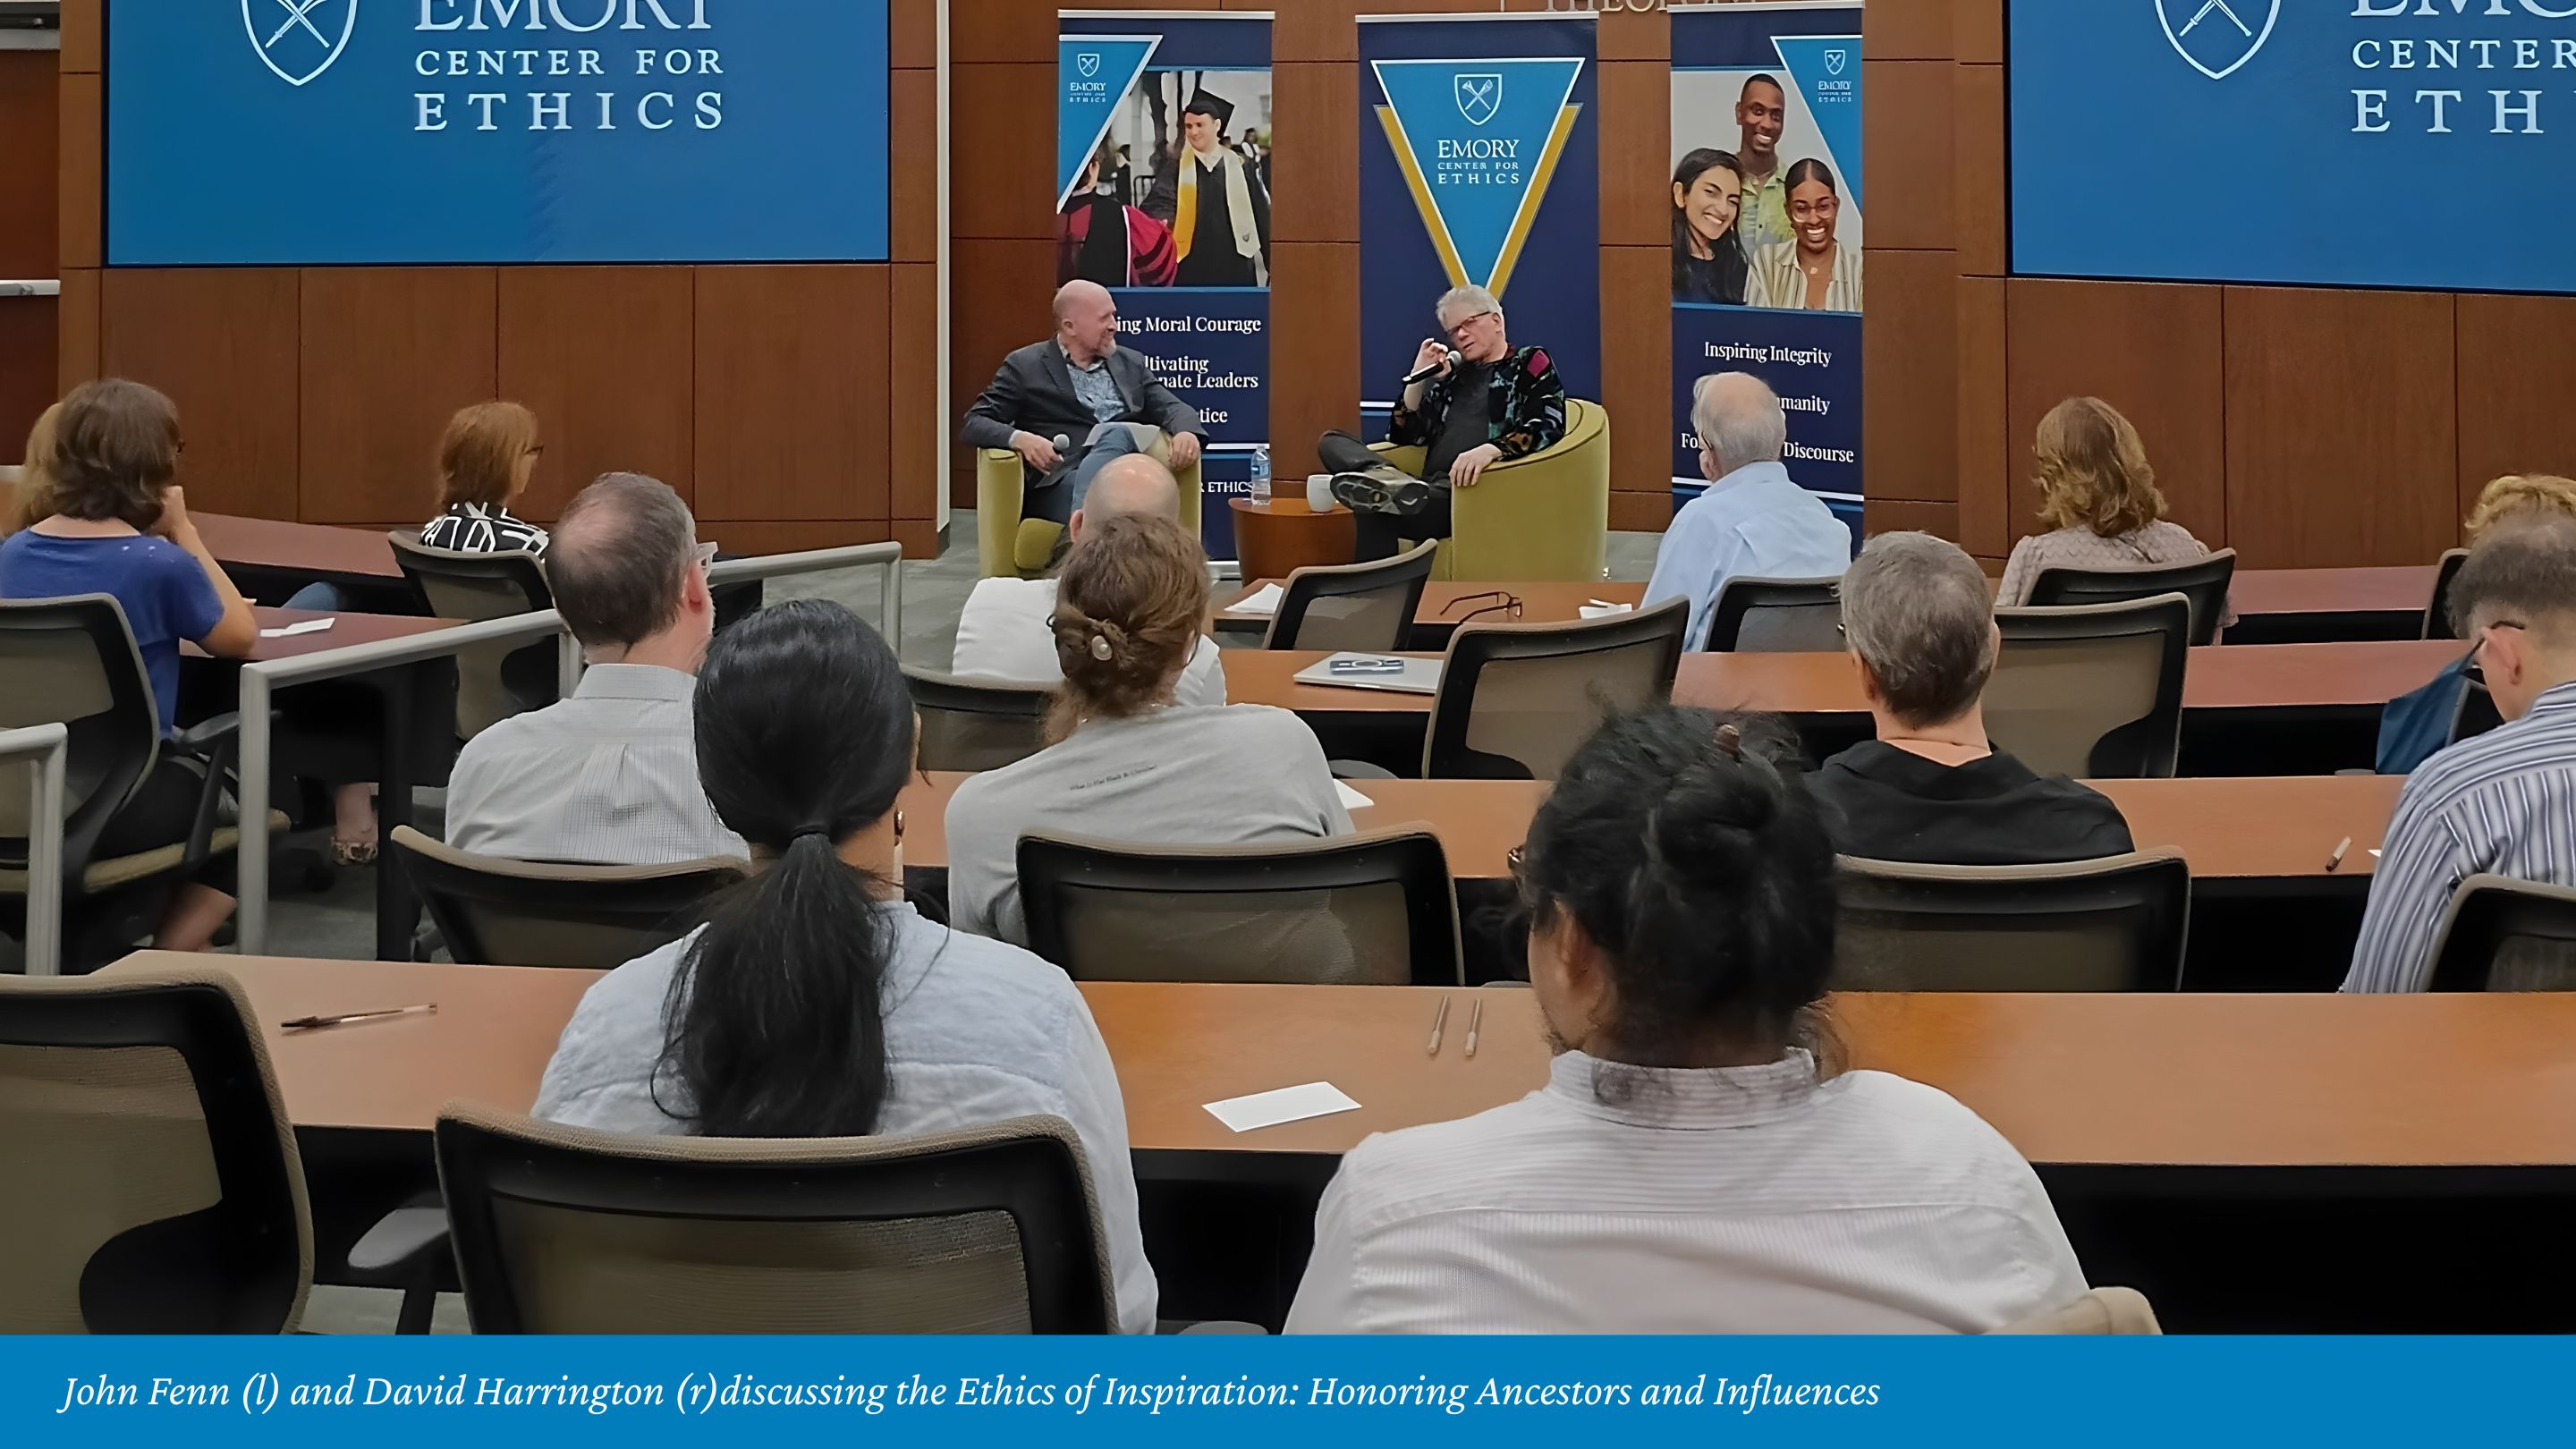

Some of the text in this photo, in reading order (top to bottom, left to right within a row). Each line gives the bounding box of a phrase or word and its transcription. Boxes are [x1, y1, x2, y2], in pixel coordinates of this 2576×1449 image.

[415, 48, 724, 76] CENTER FOR
[2351, 39, 2576, 69] CENTER
[414, 91, 723, 131] ETHICS
[2351, 89, 2576, 133] ETH
[1437, 139, 1520, 158] EMORY
[1437, 162, 1519, 170] CENTER FOR
[1437, 173, 1520, 184] ETHICS
[1146, 316, 1191, 332] Moral
[1195, 317, 1261, 335] Courage
[1144, 355, 1209, 374] ltivating
[1704, 342, 1832, 368] Inspiring Integrity
[1197, 372, 1258, 388] Leaders
[1777, 394, 1831, 416] manity
[1199, 407, 1228, 423] tice
[1784, 441, 1854, 463] Discourse
[1208, 481, 1253, 493] ETHICS
